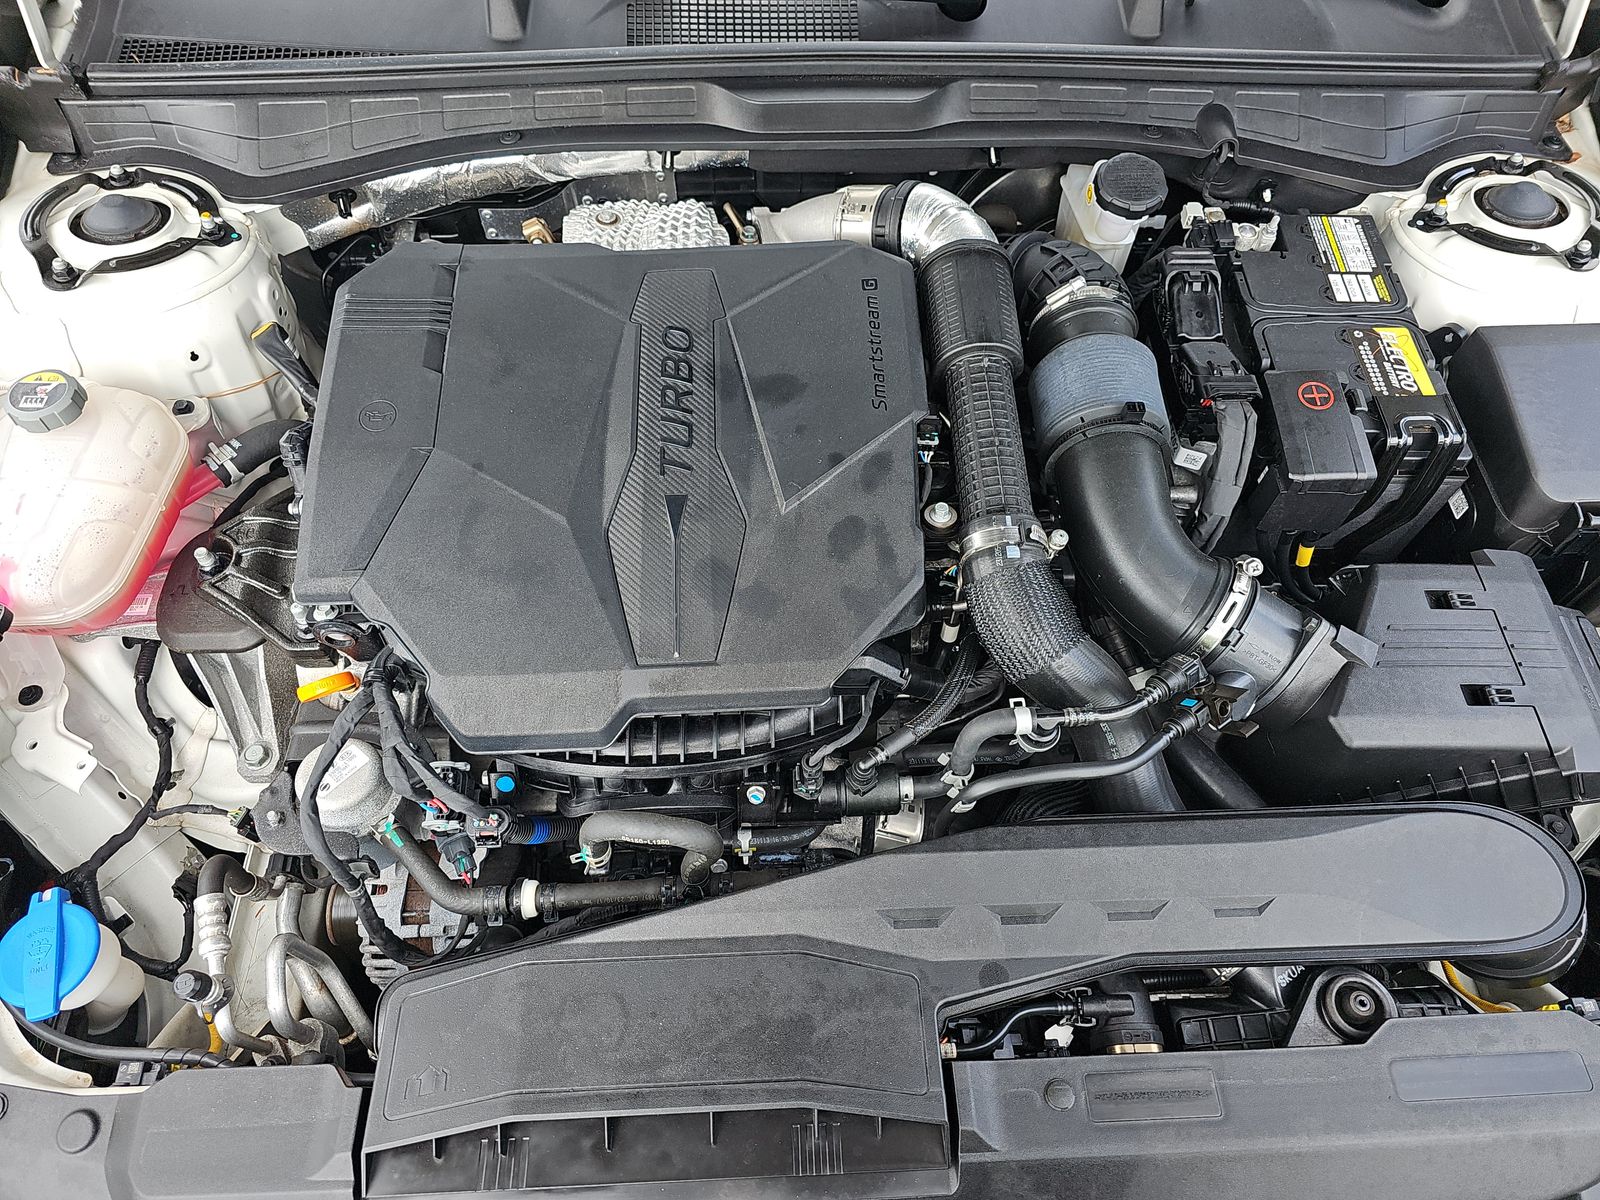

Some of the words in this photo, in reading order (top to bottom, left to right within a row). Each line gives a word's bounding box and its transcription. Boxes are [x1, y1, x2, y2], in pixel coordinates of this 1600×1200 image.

[867, 295, 888, 412] Smartstream
[1380, 331, 1419, 392] ELECTRO
[1383, 361, 1401, 389] BATTERY
[659, 325, 694, 477] TURBO
